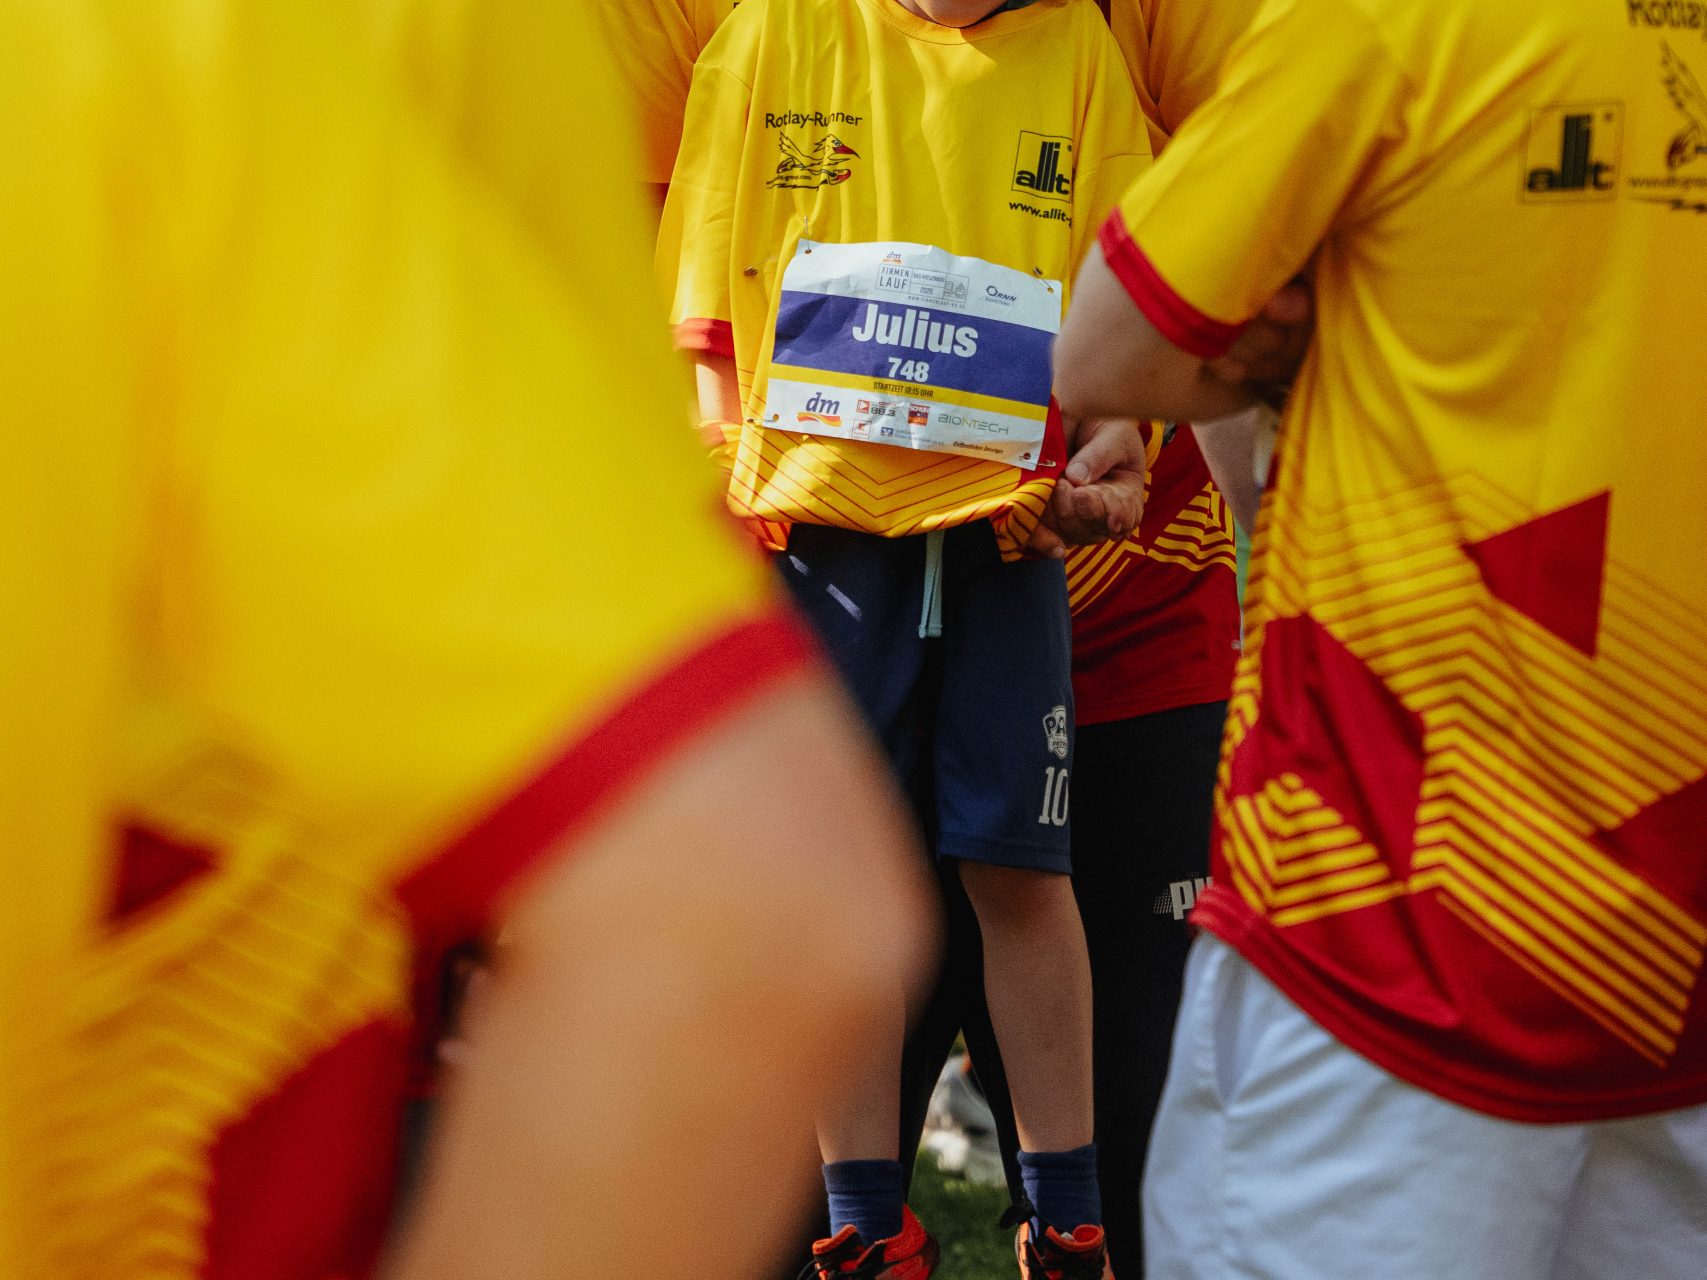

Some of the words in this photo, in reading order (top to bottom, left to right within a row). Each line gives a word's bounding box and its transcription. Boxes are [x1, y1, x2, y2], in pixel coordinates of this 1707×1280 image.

[765, 109, 863, 129] Rotlay-Runner
[1015, 141, 1071, 195] allit
[887, 251, 902, 260] dm
[879, 275, 908, 290] LAUF
[881, 266, 910, 278] FIRMEN
[852, 303, 979, 357] Julius
[888, 356, 930, 383] 748
[873, 381, 905, 394] STARTZEIT
[920, 388, 934, 398] UHR
[805, 391, 840, 415] dm
[938, 413, 1009, 435] BIONTECH
[1038, 766, 1069, 827] 10
